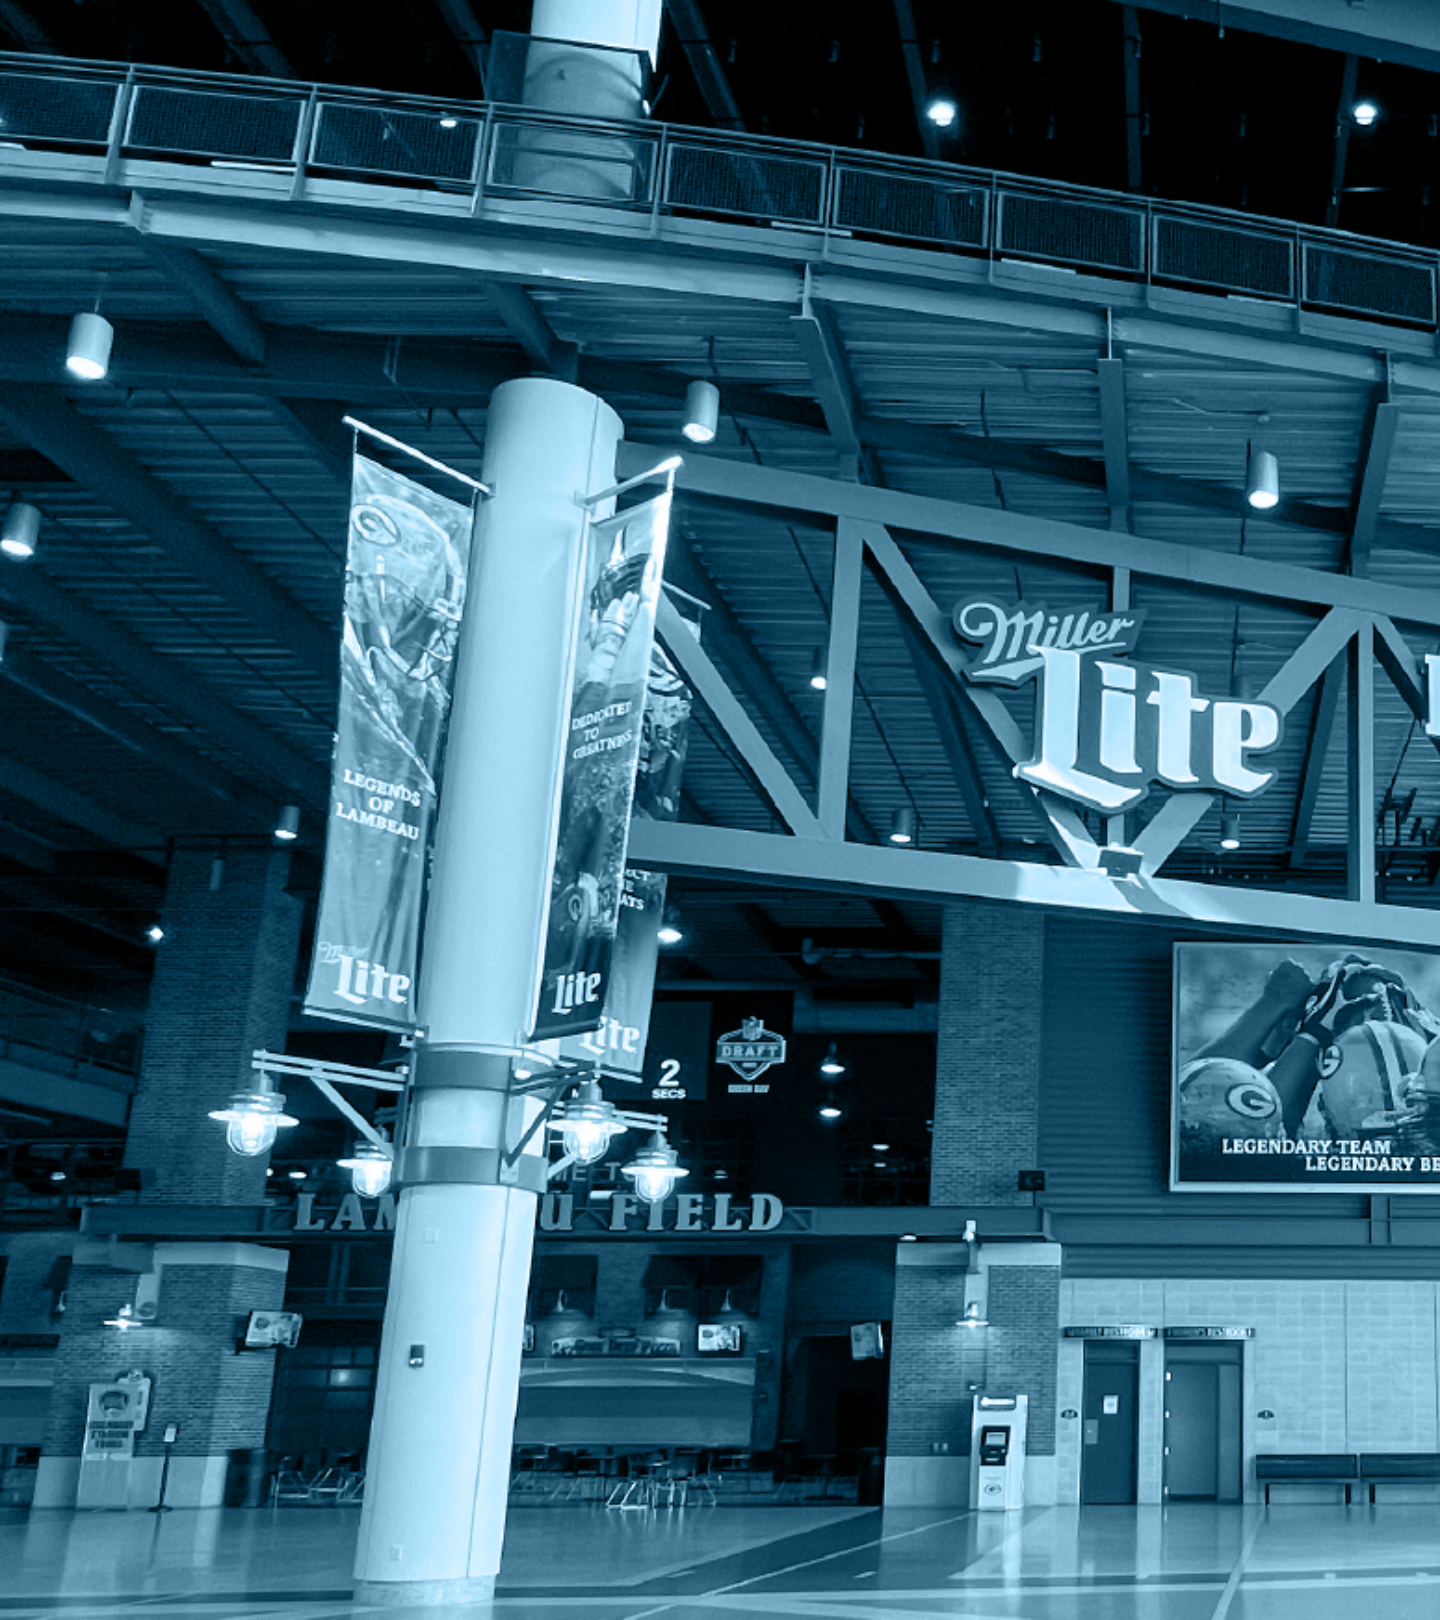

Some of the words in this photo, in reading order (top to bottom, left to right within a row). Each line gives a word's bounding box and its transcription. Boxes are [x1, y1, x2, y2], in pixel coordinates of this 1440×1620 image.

[960, 602, 1134, 663] Miller
[584, 727, 599, 741] TO
[1016, 645, 1279, 808] Lite
[343, 768, 421, 808] LEGENDS
[335, 802, 420, 841] LAMBEAU
[368, 796, 395, 816] OF
[333, 954, 410, 1005] Lite
[551, 970, 601, 1015] Lite
[722, 1045, 779, 1057] DRAFT
[658, 1058, 681, 1087] 2
[651, 1087, 687, 1099] SECS
[1221, 1138, 1331, 1155] LEGENDARY
[1334, 1139, 1392, 1155] TEAM
[1305, 1156, 1415, 1172] LEGENDARY
[608, 1193, 785, 1232] FIELD
